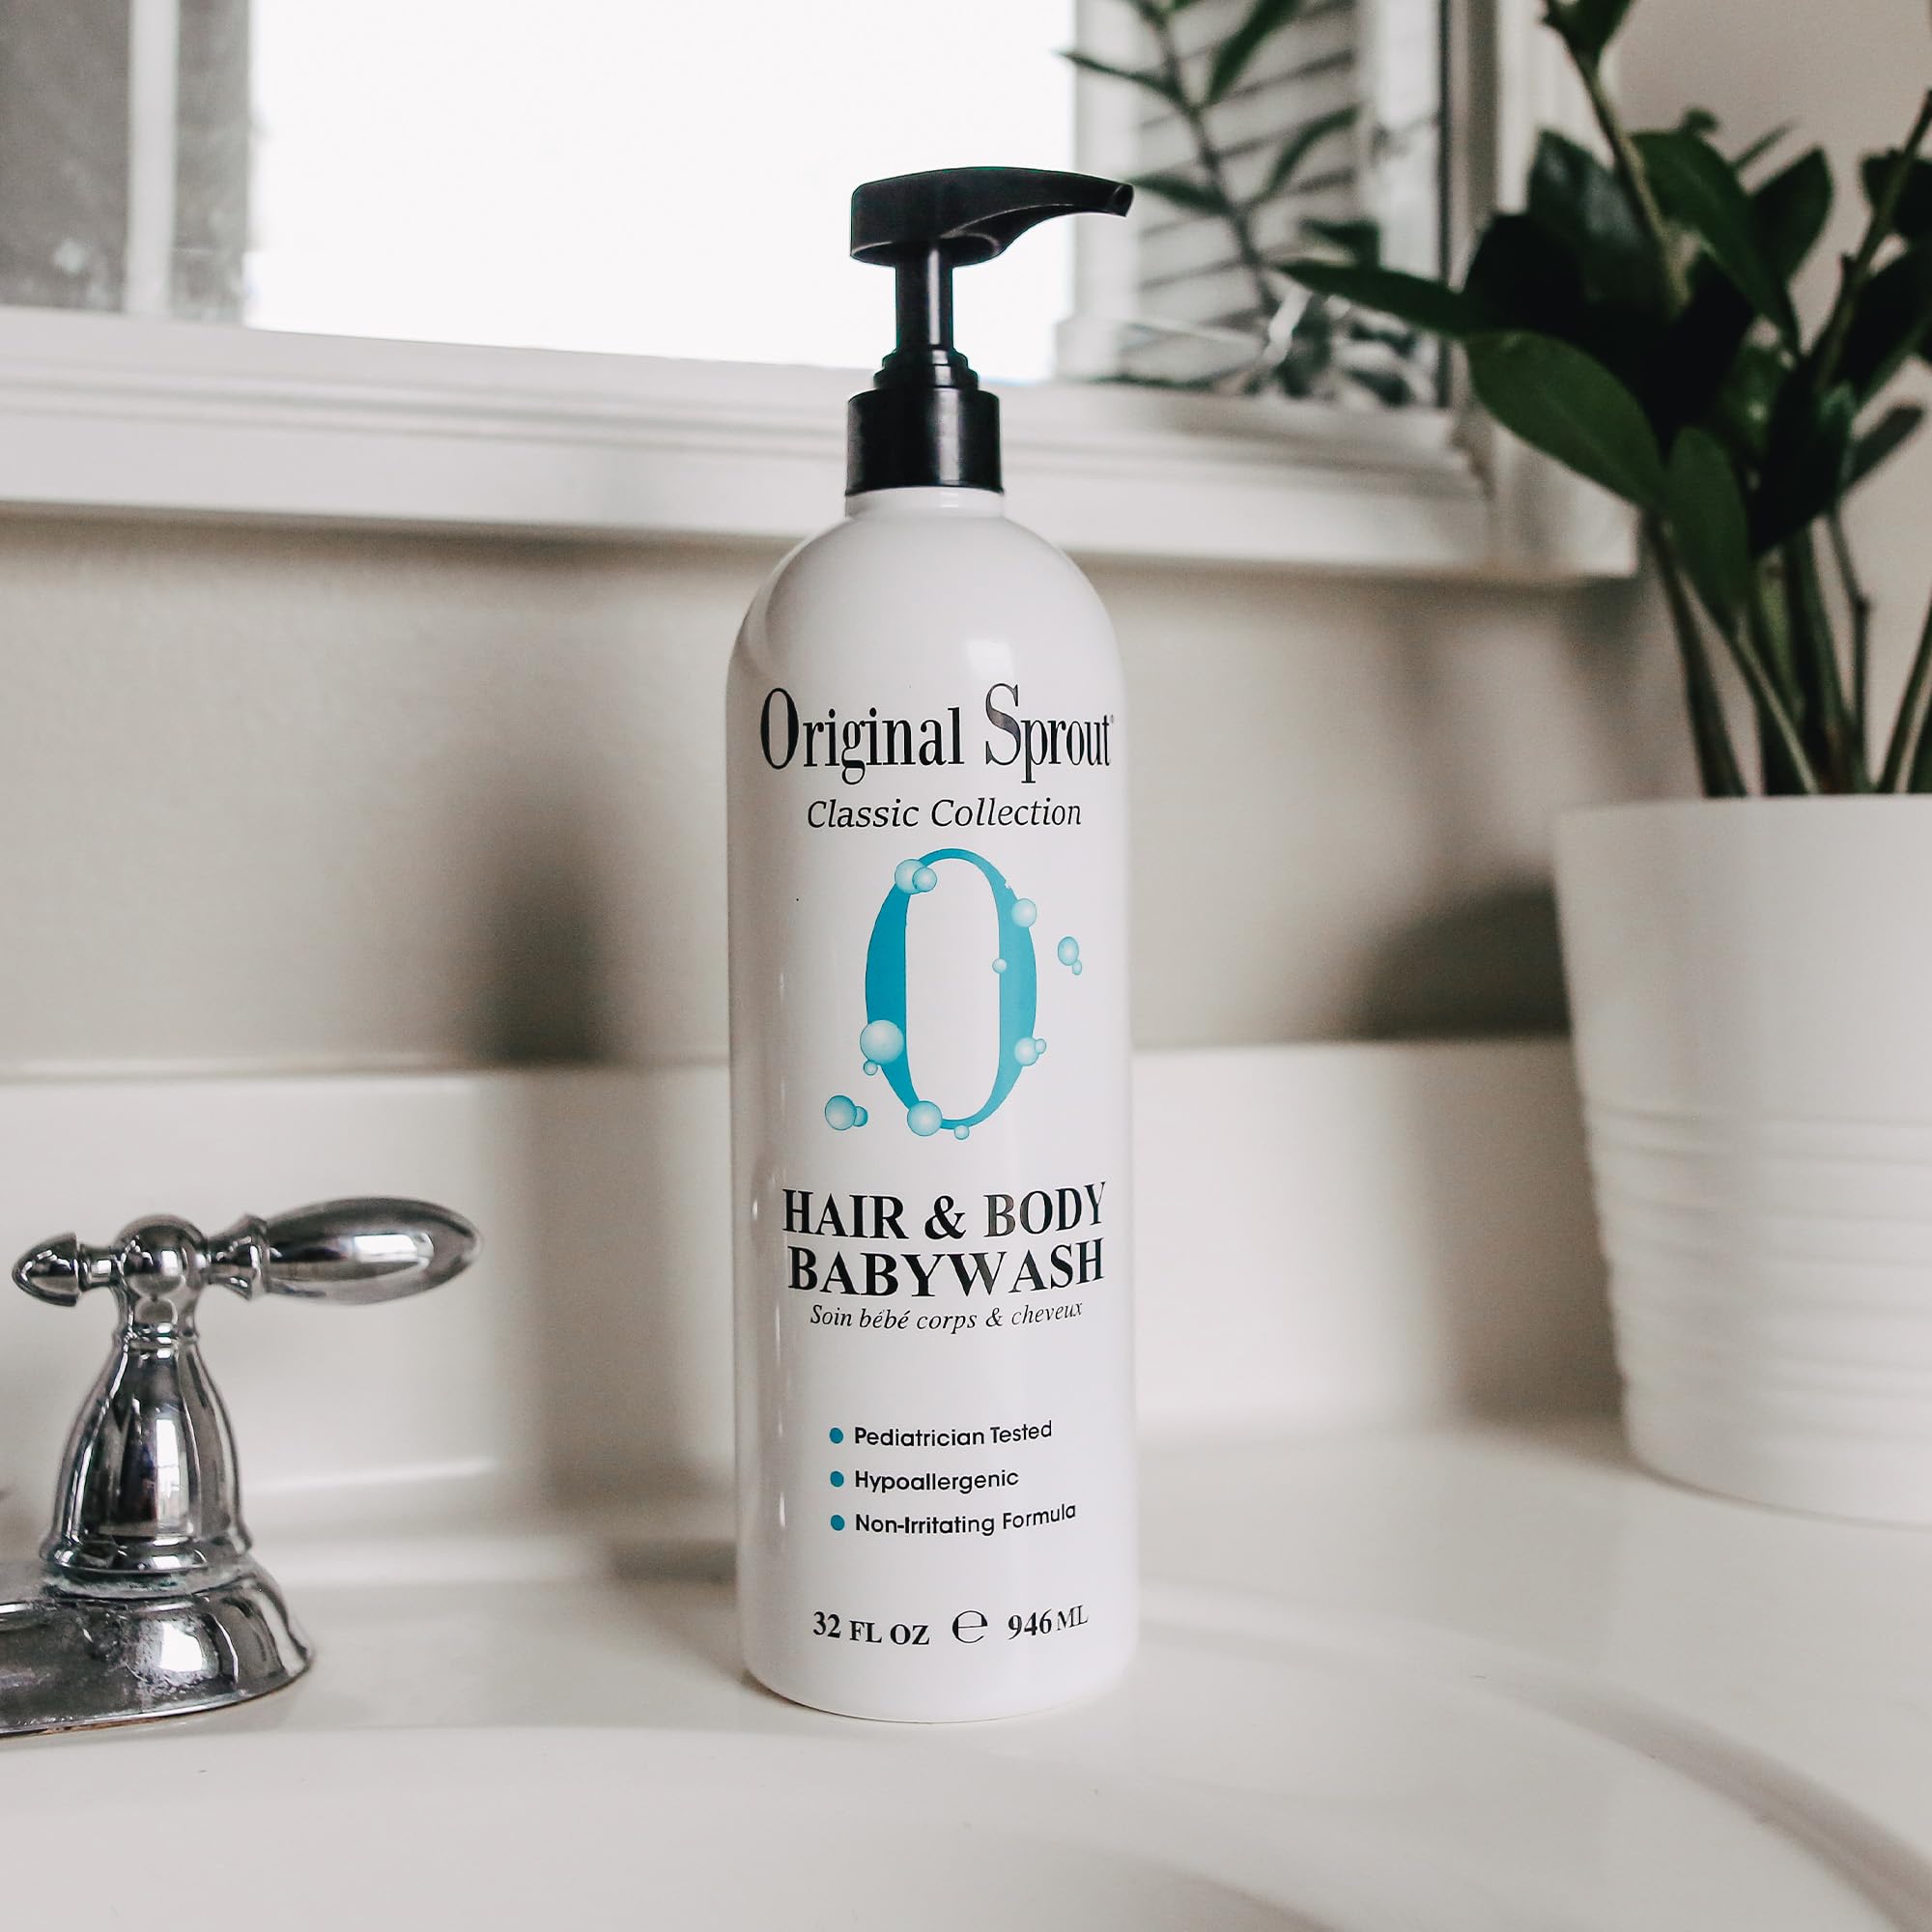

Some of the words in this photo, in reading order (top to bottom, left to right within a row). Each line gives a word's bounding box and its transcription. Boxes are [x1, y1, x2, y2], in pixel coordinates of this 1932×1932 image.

[760, 688, 965, 785] Original
[984, 682, 1111, 783] Sprout
[807, 798, 920, 828] Classic
[931, 797, 1082, 827] Collection
[781, 1188, 910, 1239] HAIR
[923, 1195, 967, 1240] &
[983, 1181, 1107, 1237] BODY
[787, 1236, 1106, 1297] BABYWASH
[810, 1304, 853, 1327] Soin
[859, 1308, 910, 1330] bébé
[916, 1313, 978, 1335] corps
[984, 1306, 1004, 1328] &
[1010, 1301, 1083, 1325] cheveux
[854, 1427, 985, 1447] Pediatrician
[989, 1420, 1053, 1444] Tested
[854, 1470, 1020, 1493] Hypoallergenic
[855, 1514, 995, 1536] Non-Irritating
[1002, 1503, 1077, 1530] Formula
[812, 1610, 841, 1638] 32
[849, 1620, 883, 1644] FL
[890, 1624, 930, 1646] OZ
[1008, 1608, 1053, 1640] 946
[1056, 1605, 1090, 1631] ML
